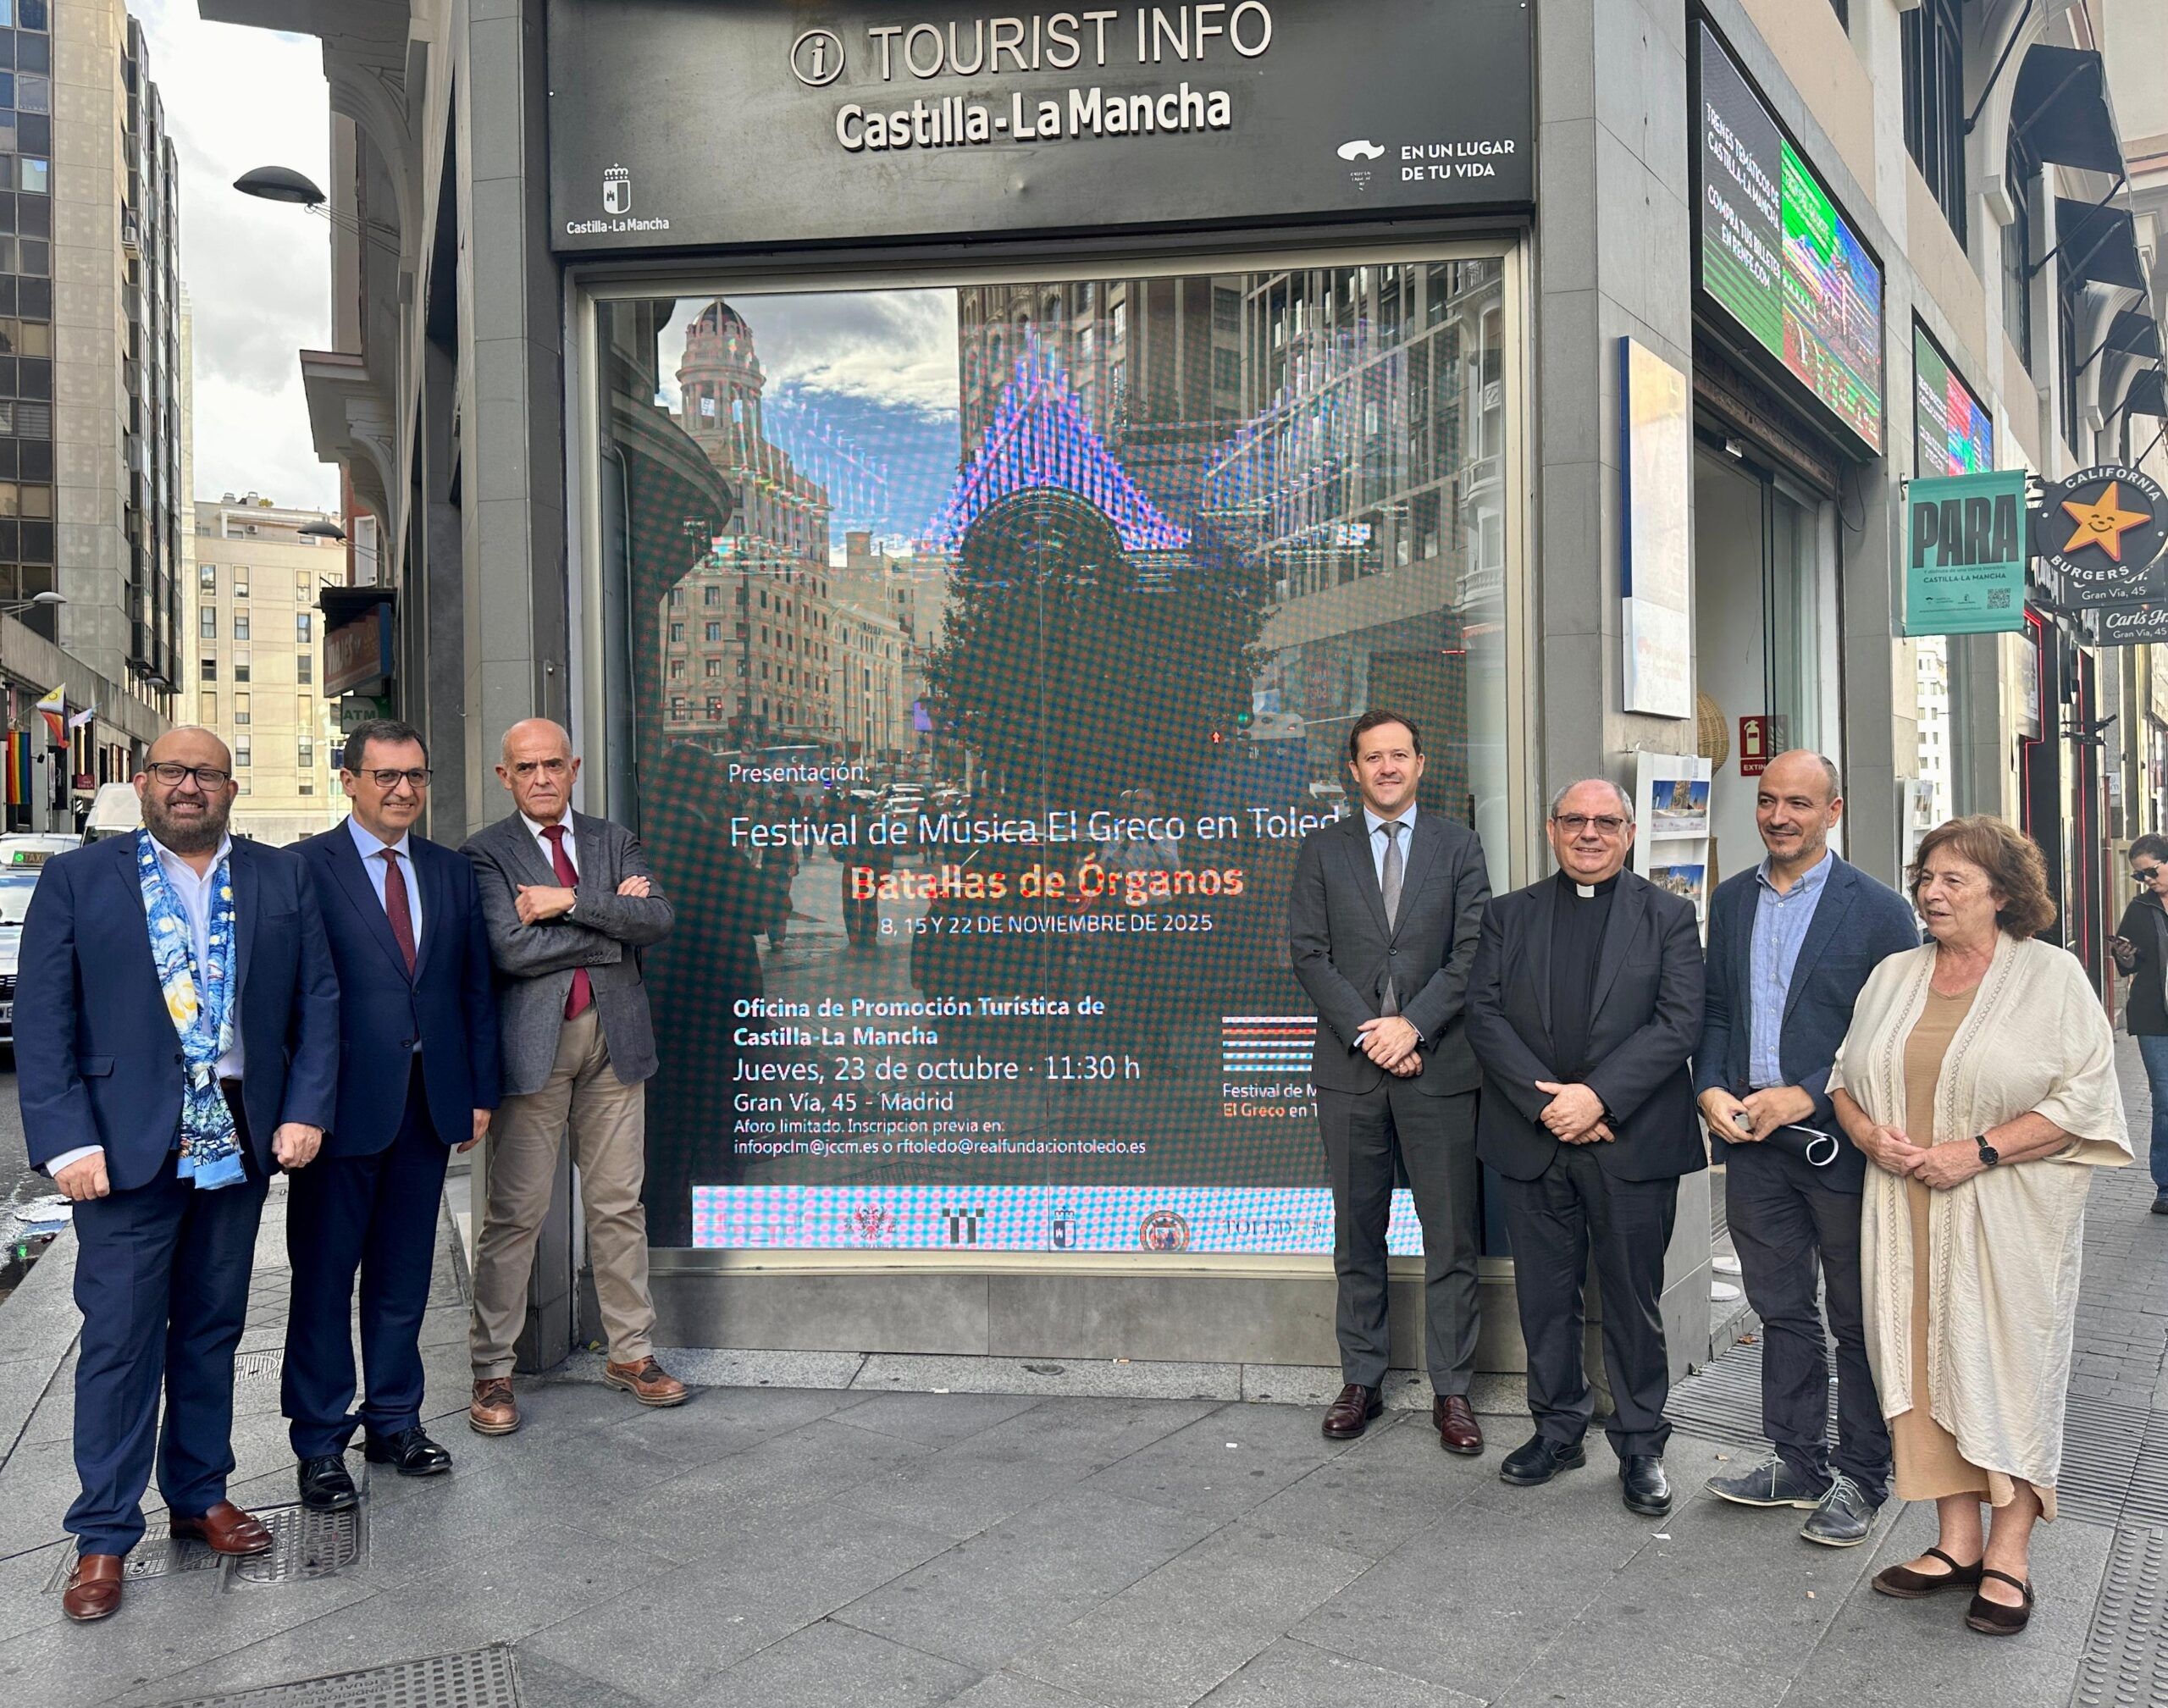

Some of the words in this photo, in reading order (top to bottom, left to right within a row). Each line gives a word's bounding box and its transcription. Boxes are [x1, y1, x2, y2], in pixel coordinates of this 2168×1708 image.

[868, 10, 1118, 80] TOURIST
[1137, 0, 1272, 62] INFO
[836, 91, 1061, 152] Castilla-La
[1068, 82, 1232, 136] Mancha
[1402, 146, 1426, 160] EN
[1428, 144, 1452, 158] UN
[1457, 140, 1515, 158] LUGAR
[1706, 102, 1734, 151] TRENES
[1735, 137, 1770, 197] TEMÁTICOS
[1771, 185, 1779, 209] DE
[1402, 167, 1424, 181] DE
[1428, 165, 1451, 180] TU
[1454, 163, 1495, 178] VIDA
[1708, 130, 1752, 199] CASTILLA-LA
[1752, 185, 1779, 232] MANCHA
[567, 219, 626, 235] Castilla-La
[628, 217, 670, 231] Mancha
[1708, 184, 1739, 234] COMPRA
[1739, 218, 1753, 249] TUS
[1754, 233, 1781, 279] BILLETES
[1722, 223, 1731, 248] EN
[1733, 235, 1770, 291] RENFE.COM
[2065, 467, 2161, 502] CALIFORNIA
[1912, 494, 2019, 568] PARA
[2050, 555, 2130, 581] BURGERS
[2082, 591, 2106, 600] Gran
[2131, 586, 2146, 595] 45
[2113, 630, 2133, 638] Gran
[344, 710, 375, 720] ATM
[731, 814, 856, 847] Festival
[869, 813, 908, 845] de
[919, 813, 1037, 844] Música
[1048, 810, 1076, 842] El
[1088, 810, 1185, 842] Greco
[1197, 815, 1237, 839] en
[1247, 805, 1340, 838] Toled
[25, 854, 44, 863] TAXI
[851, 865, 1007, 900] Batallas
[1020, 864, 1065, 898] de
[1078, 851, 1244, 906] Órganos
[881, 918, 898, 937] 8,
[906, 917, 926, 933] 15
[932, 917, 943, 933] Y
[948, 917, 972, 933] 22
[977, 917, 1004, 933] DE
[1009, 915, 1125, 933] NOVIEMBRE
[1131, 915, 1158, 932] DE
[1163, 914, 1213, 931] 2025
[733, 998, 810, 1018] Oficina
[818, 998, 843, 1017] de
[852, 995, 971, 1016] Promoción
[978, 995, 1070, 1016] Turística
[1077, 996, 1105, 1015] de
[733, 1026, 845, 1047] Castilla-La
[854, 1025, 937, 1045] Mancha
[733, 1058, 825, 1084] Jueves,
[834, 1057, 866, 1081] 23
[876, 1056, 908, 1081] de
[917, 1056, 1019, 1081] octubre
[1046, 1055, 1115, 1080] 11:30
[1125, 1055, 1140, 1079] h
[1223, 1083, 1280, 1098] Festival
[1283, 1083, 1302, 1098] de
[734, 1093, 782, 1112] Gran
[788, 1092, 825, 1114] Vía,
[832, 1093, 857, 1112] 45
[881, 1092, 954, 1112] Madrid
[1224, 1103, 1237, 1118] El
[1241, 1103, 1285, 1118] Greco
[1290, 1106, 1308, 1118] en
[734, 1119, 775, 1133] Aforo
[780, 1119, 844, 1133] limitado.
[848, 1118, 927, 1136] Inscripción
[933, 1119, 979, 1136] previa
[983, 1121, 1004, 1133] en:
[734, 1139, 878, 1158] infoopclm@jccm.es
[882, 1142, 893, 1153] o
[897, 1138, 1146, 1154] rftoledo@realfundaciontoledo.es
